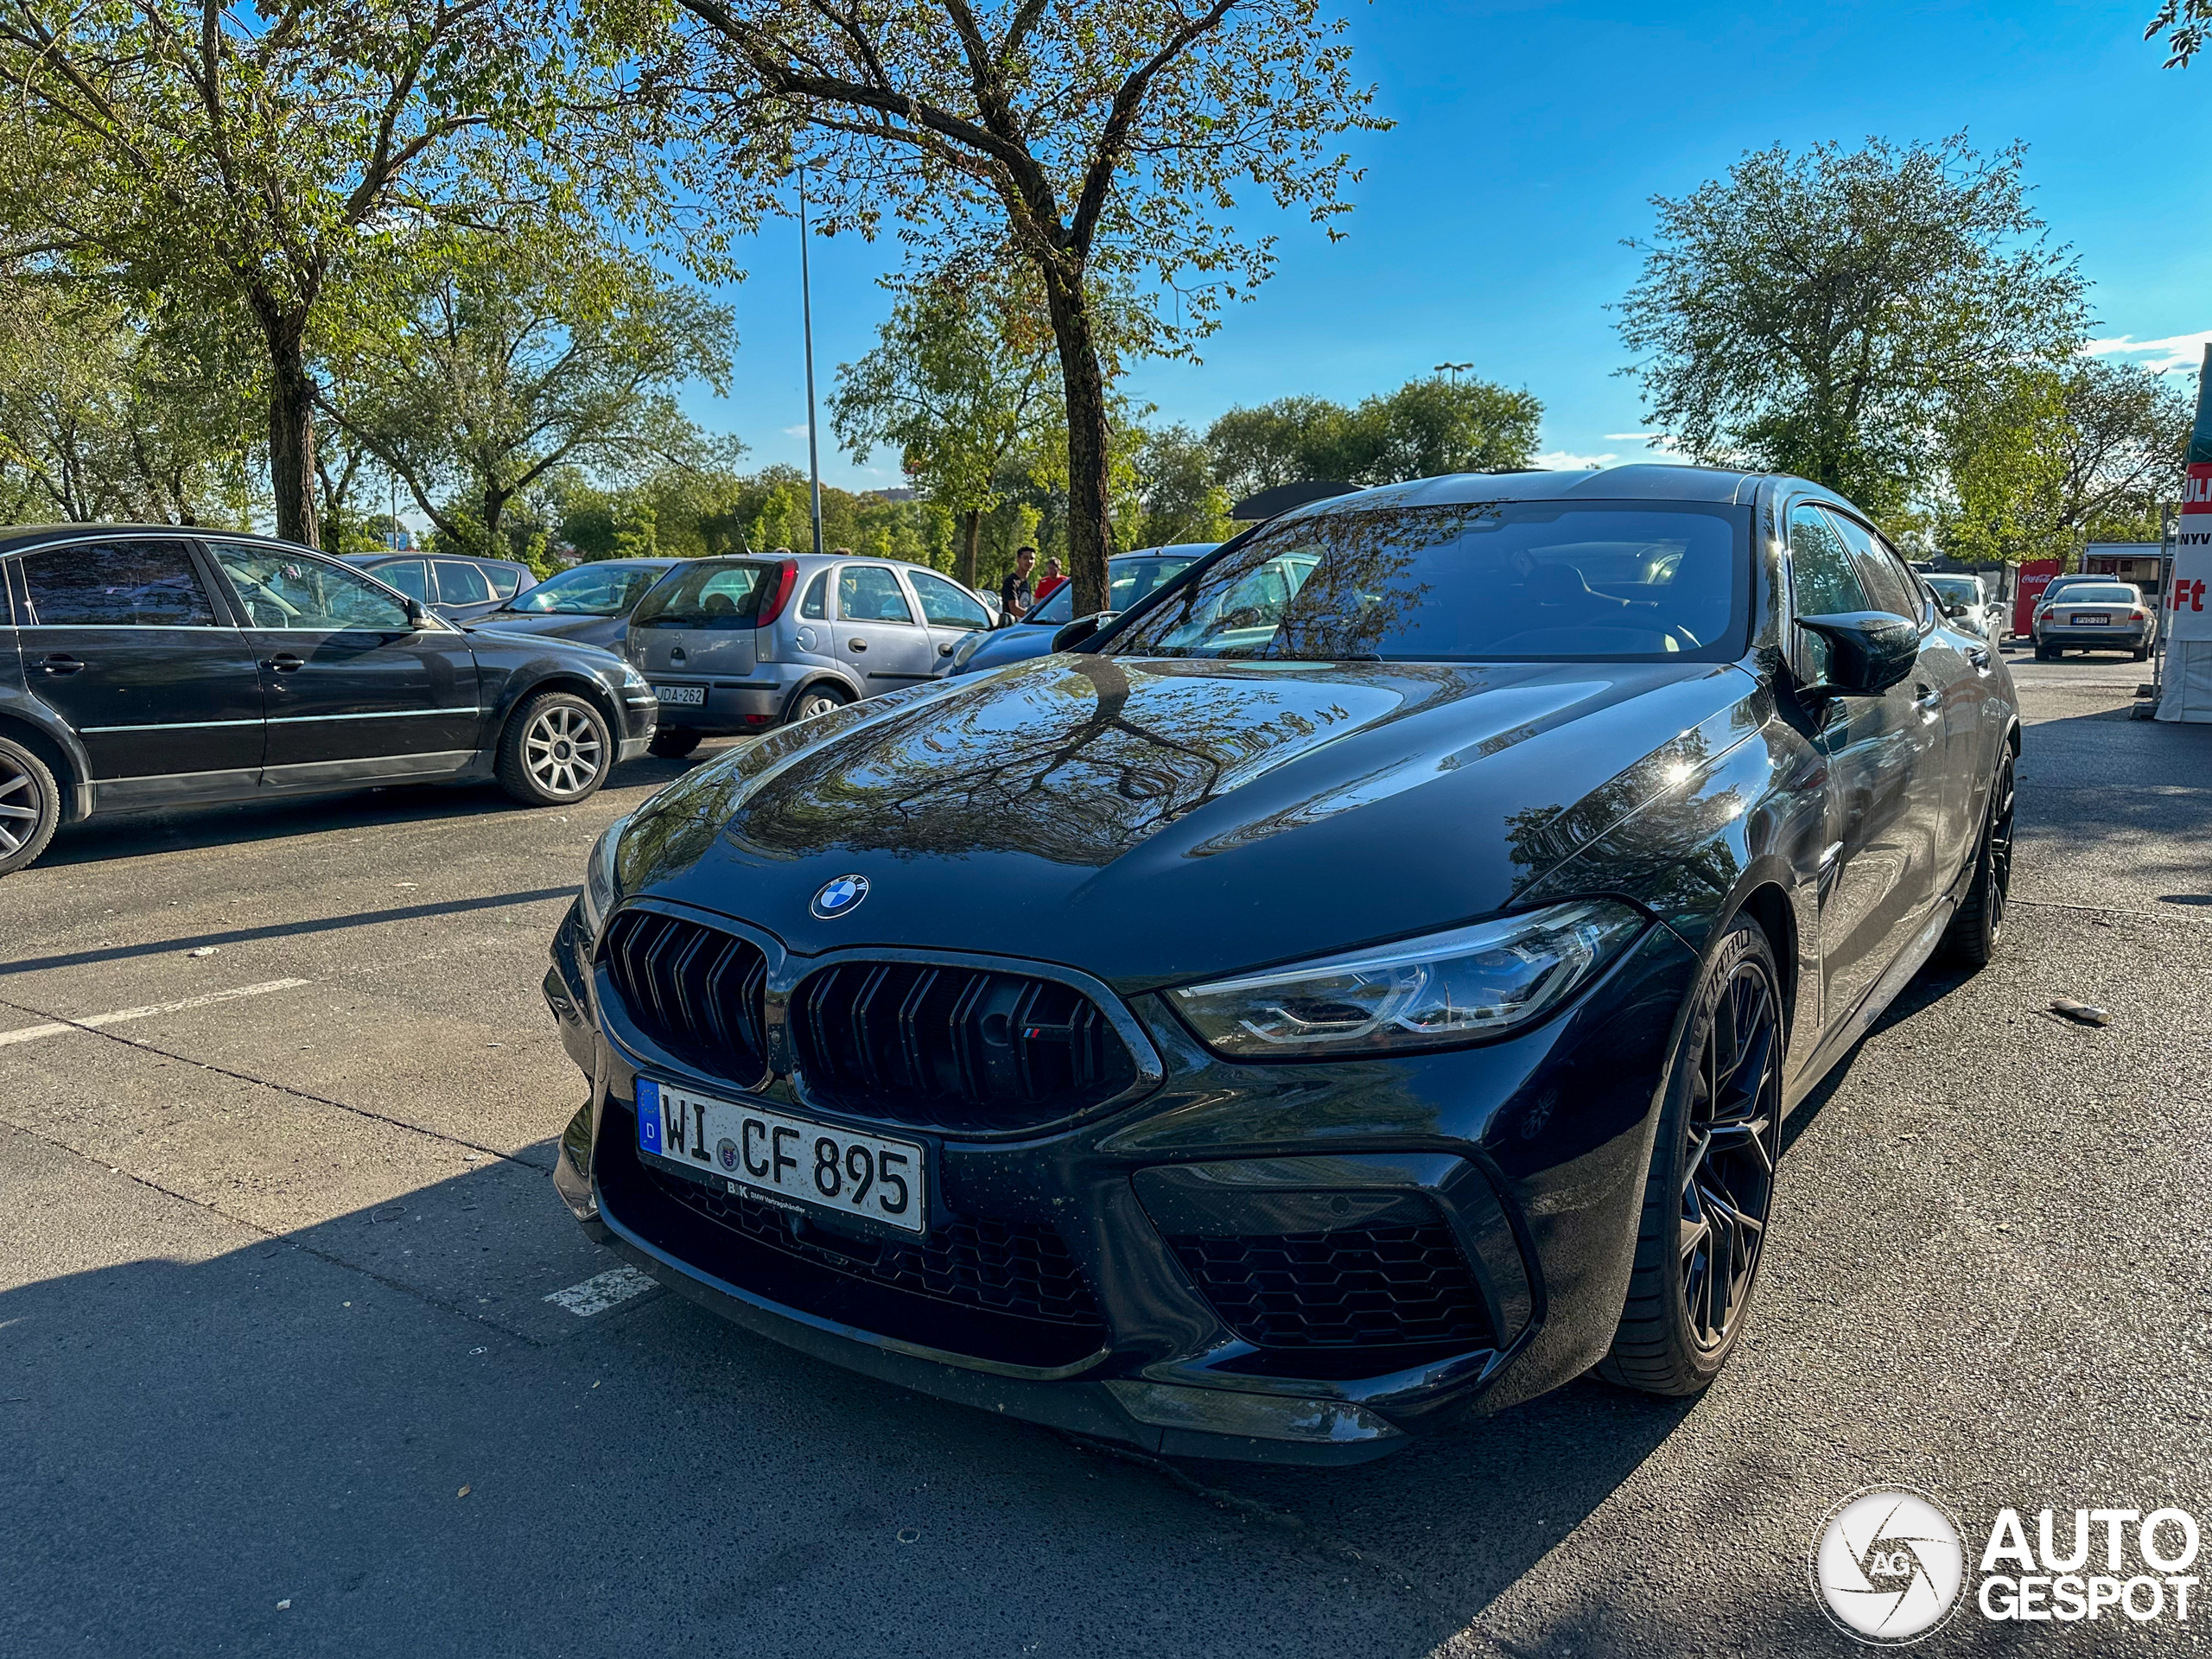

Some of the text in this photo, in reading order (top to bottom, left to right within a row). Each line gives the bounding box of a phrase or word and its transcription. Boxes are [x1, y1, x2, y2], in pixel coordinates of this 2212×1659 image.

[2177, 533, 2211, 545] NYV
[2174, 579, 2206, 612] Ft
[657, 688, 702, 702] JDA-262
[830, 874, 868, 891] BMW
[645, 1122, 655, 1140] D
[662, 1094, 908, 1214] WI CF 895
